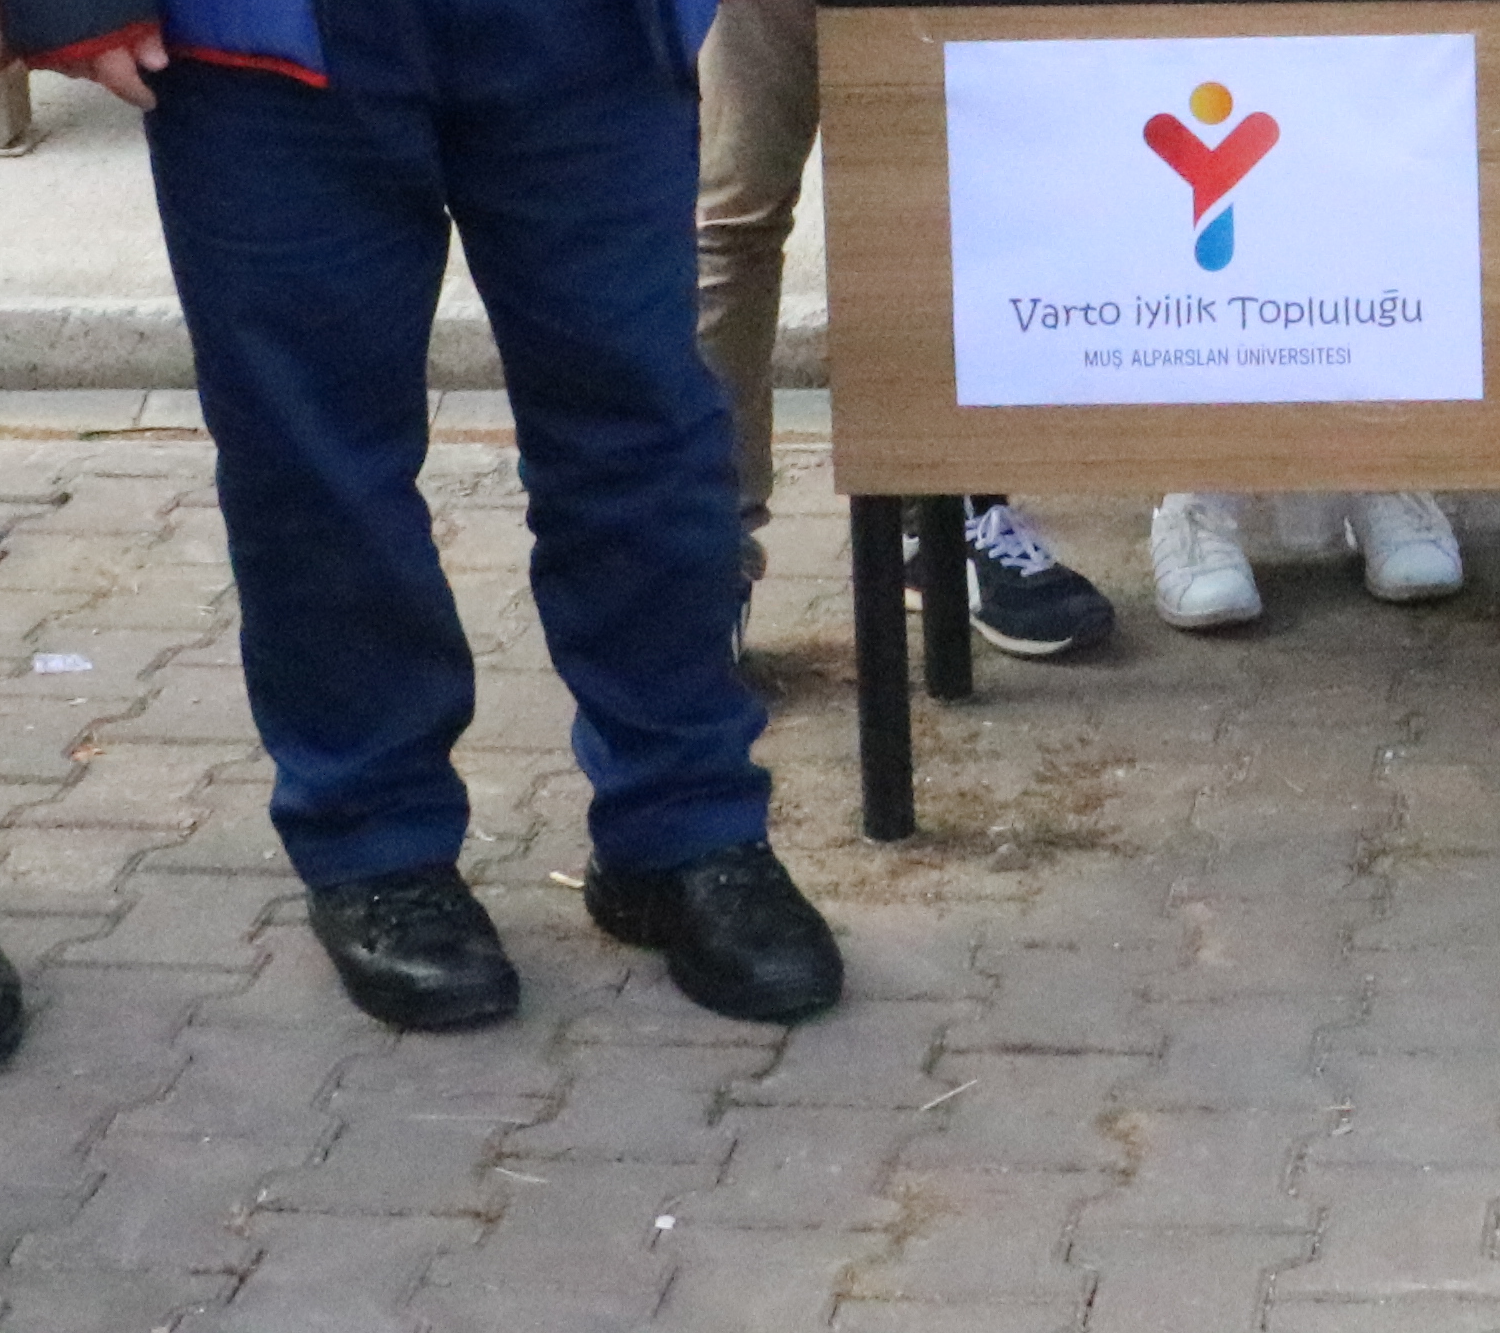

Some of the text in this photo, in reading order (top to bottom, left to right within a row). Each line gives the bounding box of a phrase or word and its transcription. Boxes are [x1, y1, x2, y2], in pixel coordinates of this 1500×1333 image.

[1008, 288, 1424, 333] Varto iyilik Topluluğu
[1084, 342, 1352, 368] MUŞ ALPARSLAN ÜNİVERSİTESİ
